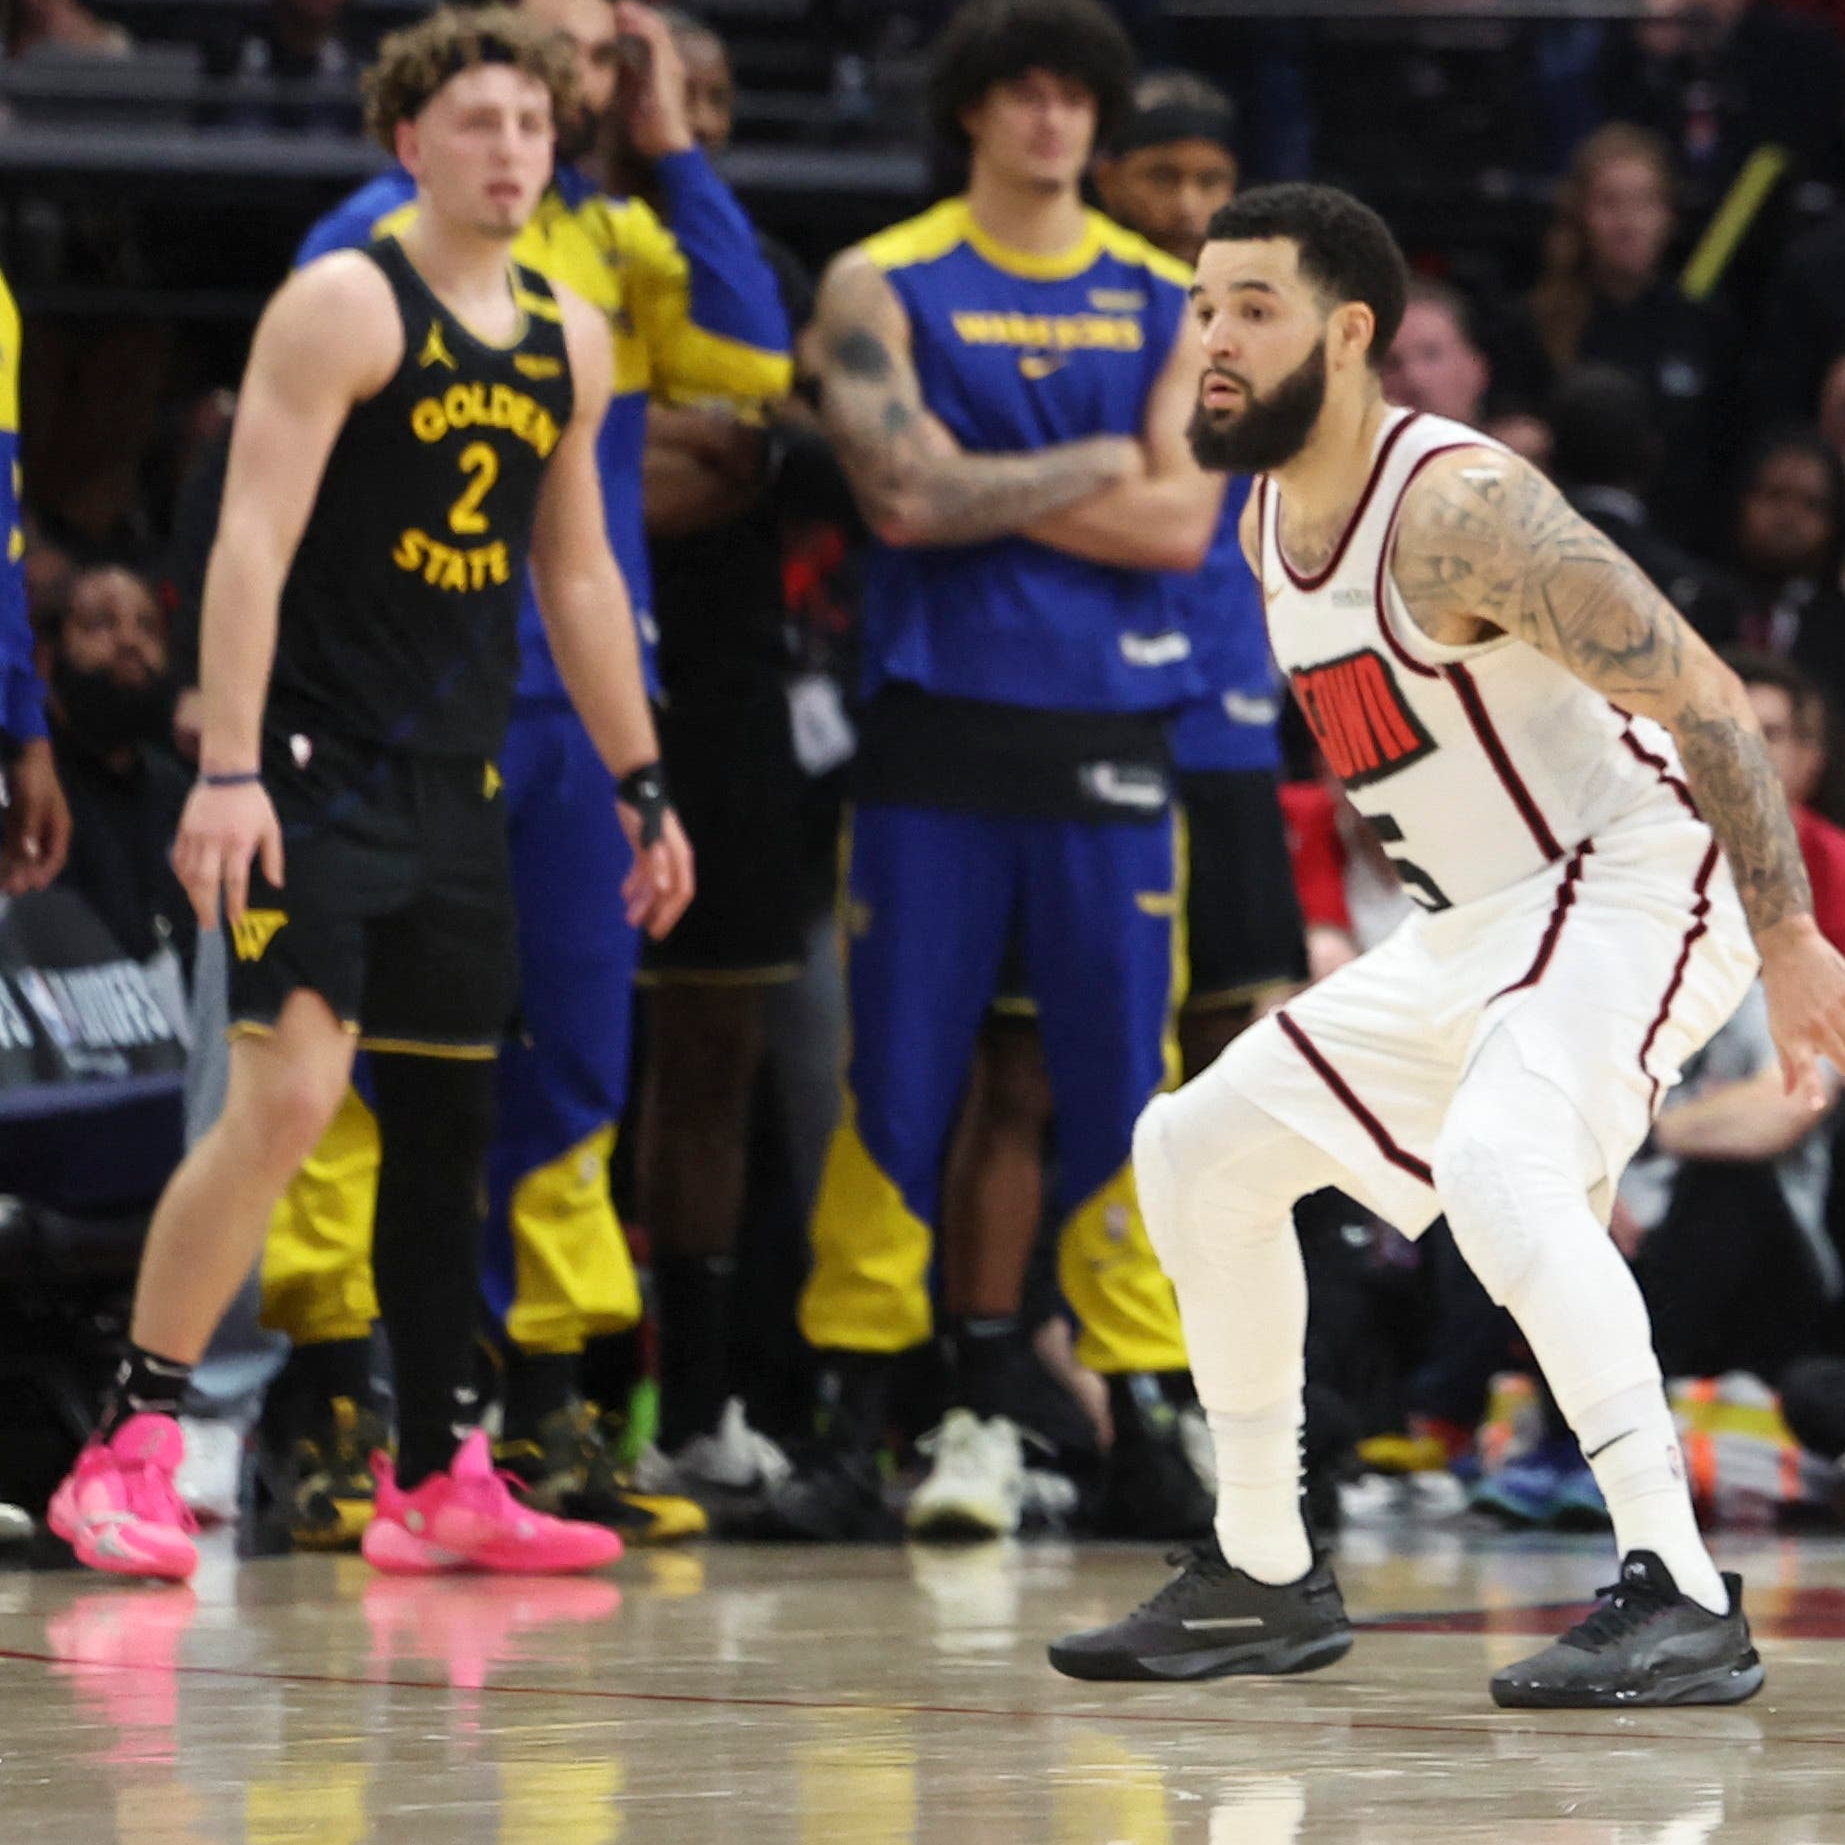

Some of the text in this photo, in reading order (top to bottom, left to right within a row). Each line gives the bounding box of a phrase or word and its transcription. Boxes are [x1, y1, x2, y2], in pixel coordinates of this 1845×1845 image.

[411, 381, 560, 459] GOLDEN
[448, 440, 500, 534] 2
[393, 528, 511, 593] STATE
